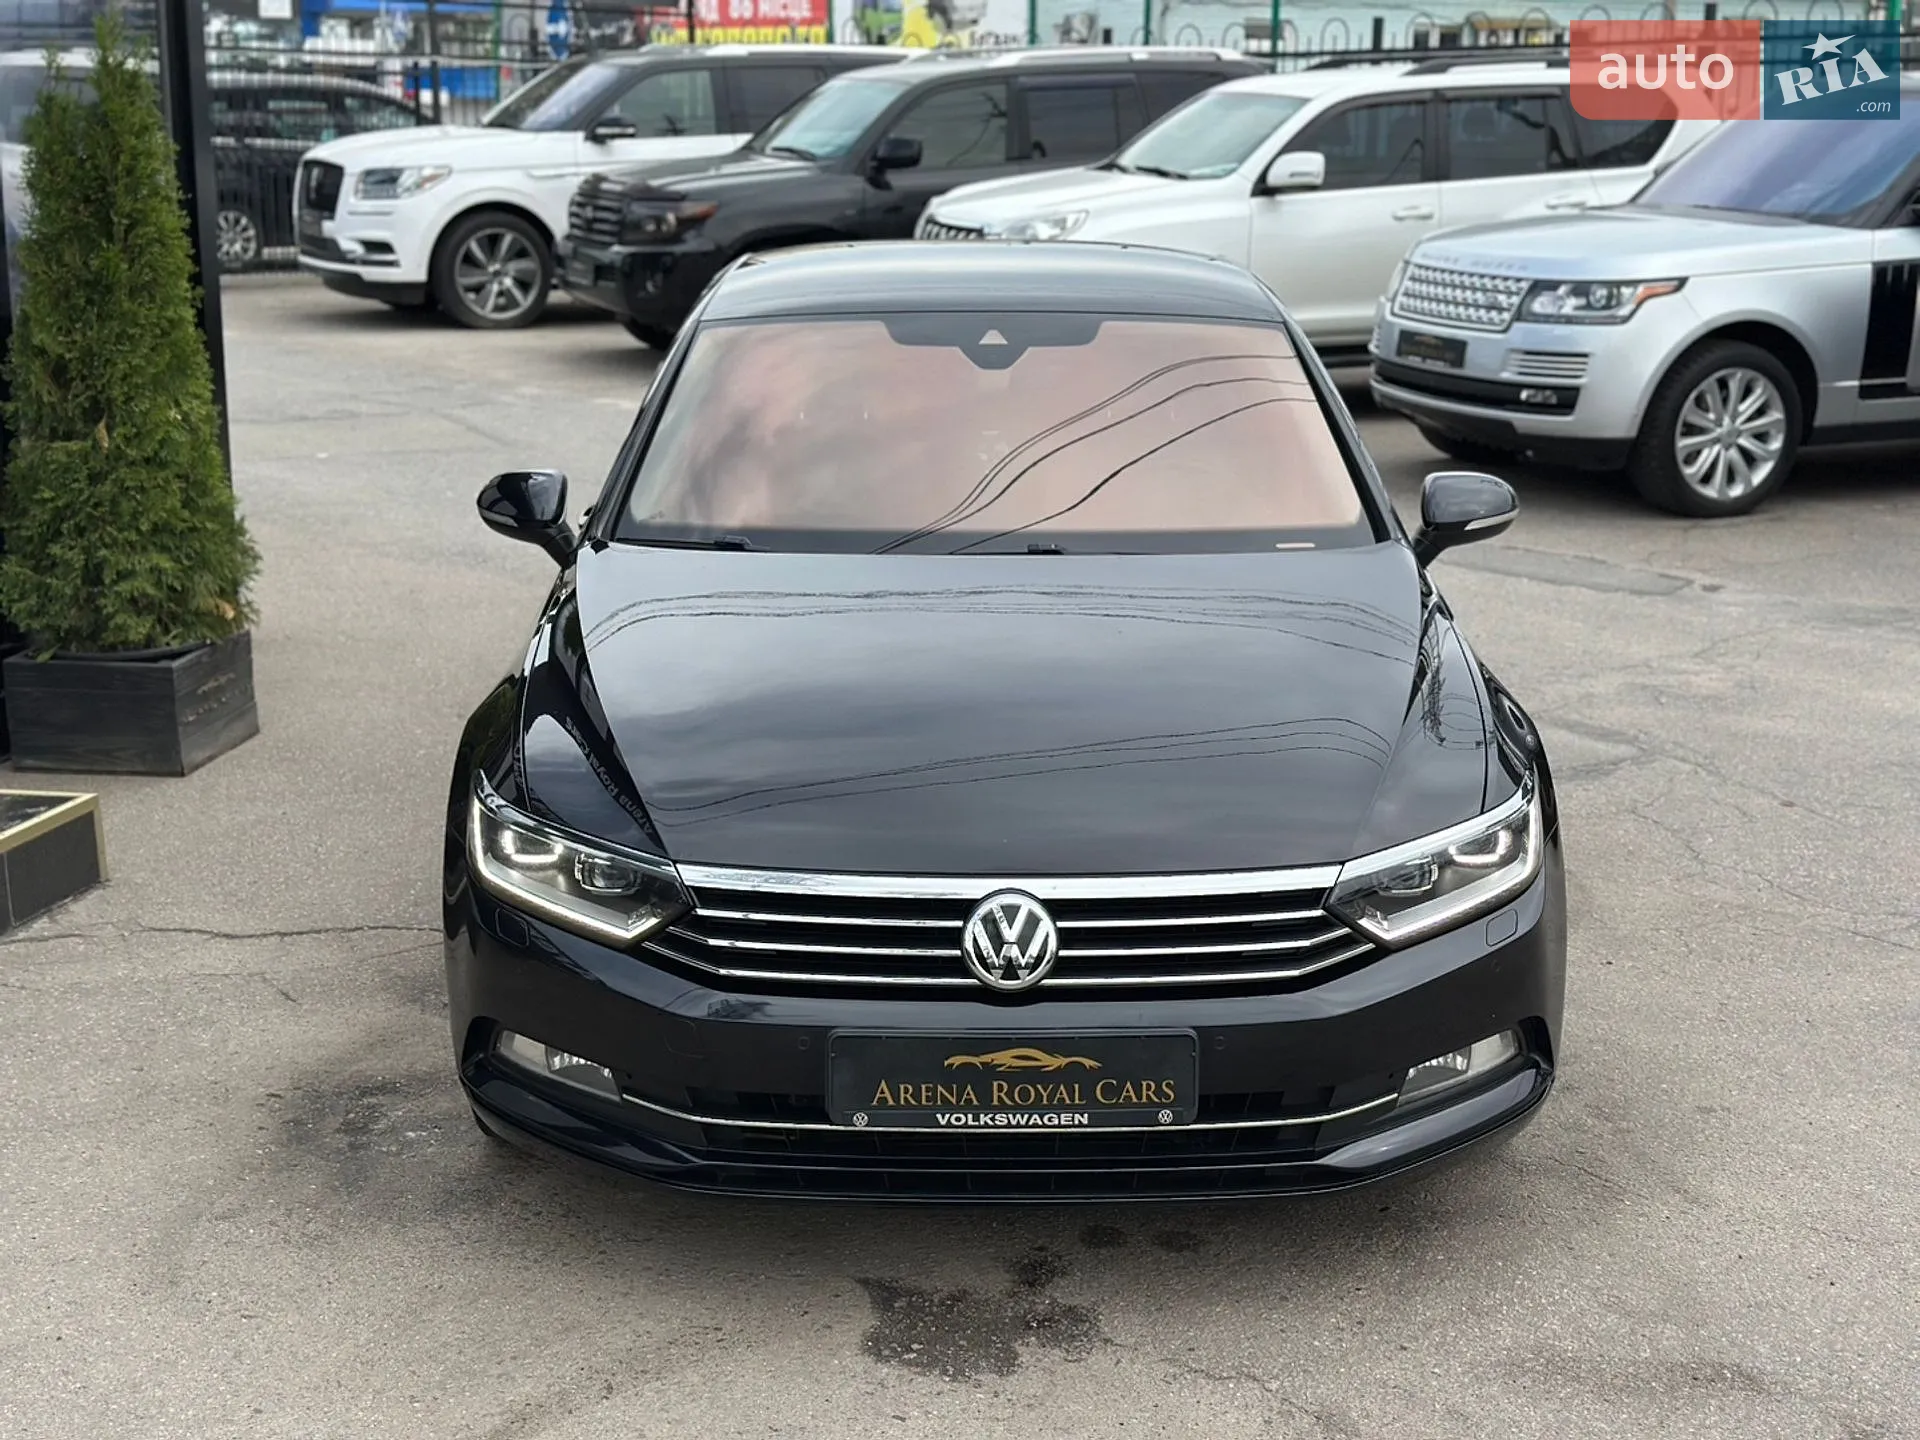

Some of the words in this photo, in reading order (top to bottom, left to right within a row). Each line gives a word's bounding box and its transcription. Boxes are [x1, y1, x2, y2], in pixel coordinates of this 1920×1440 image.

[871, 1079, 980, 1107] ARENA
[991, 1079, 1087, 1106] ROYAL
[1095, 1078, 1175, 1105] CARS
[935, 1112, 1089, 1126] VOLKSWAGEN
